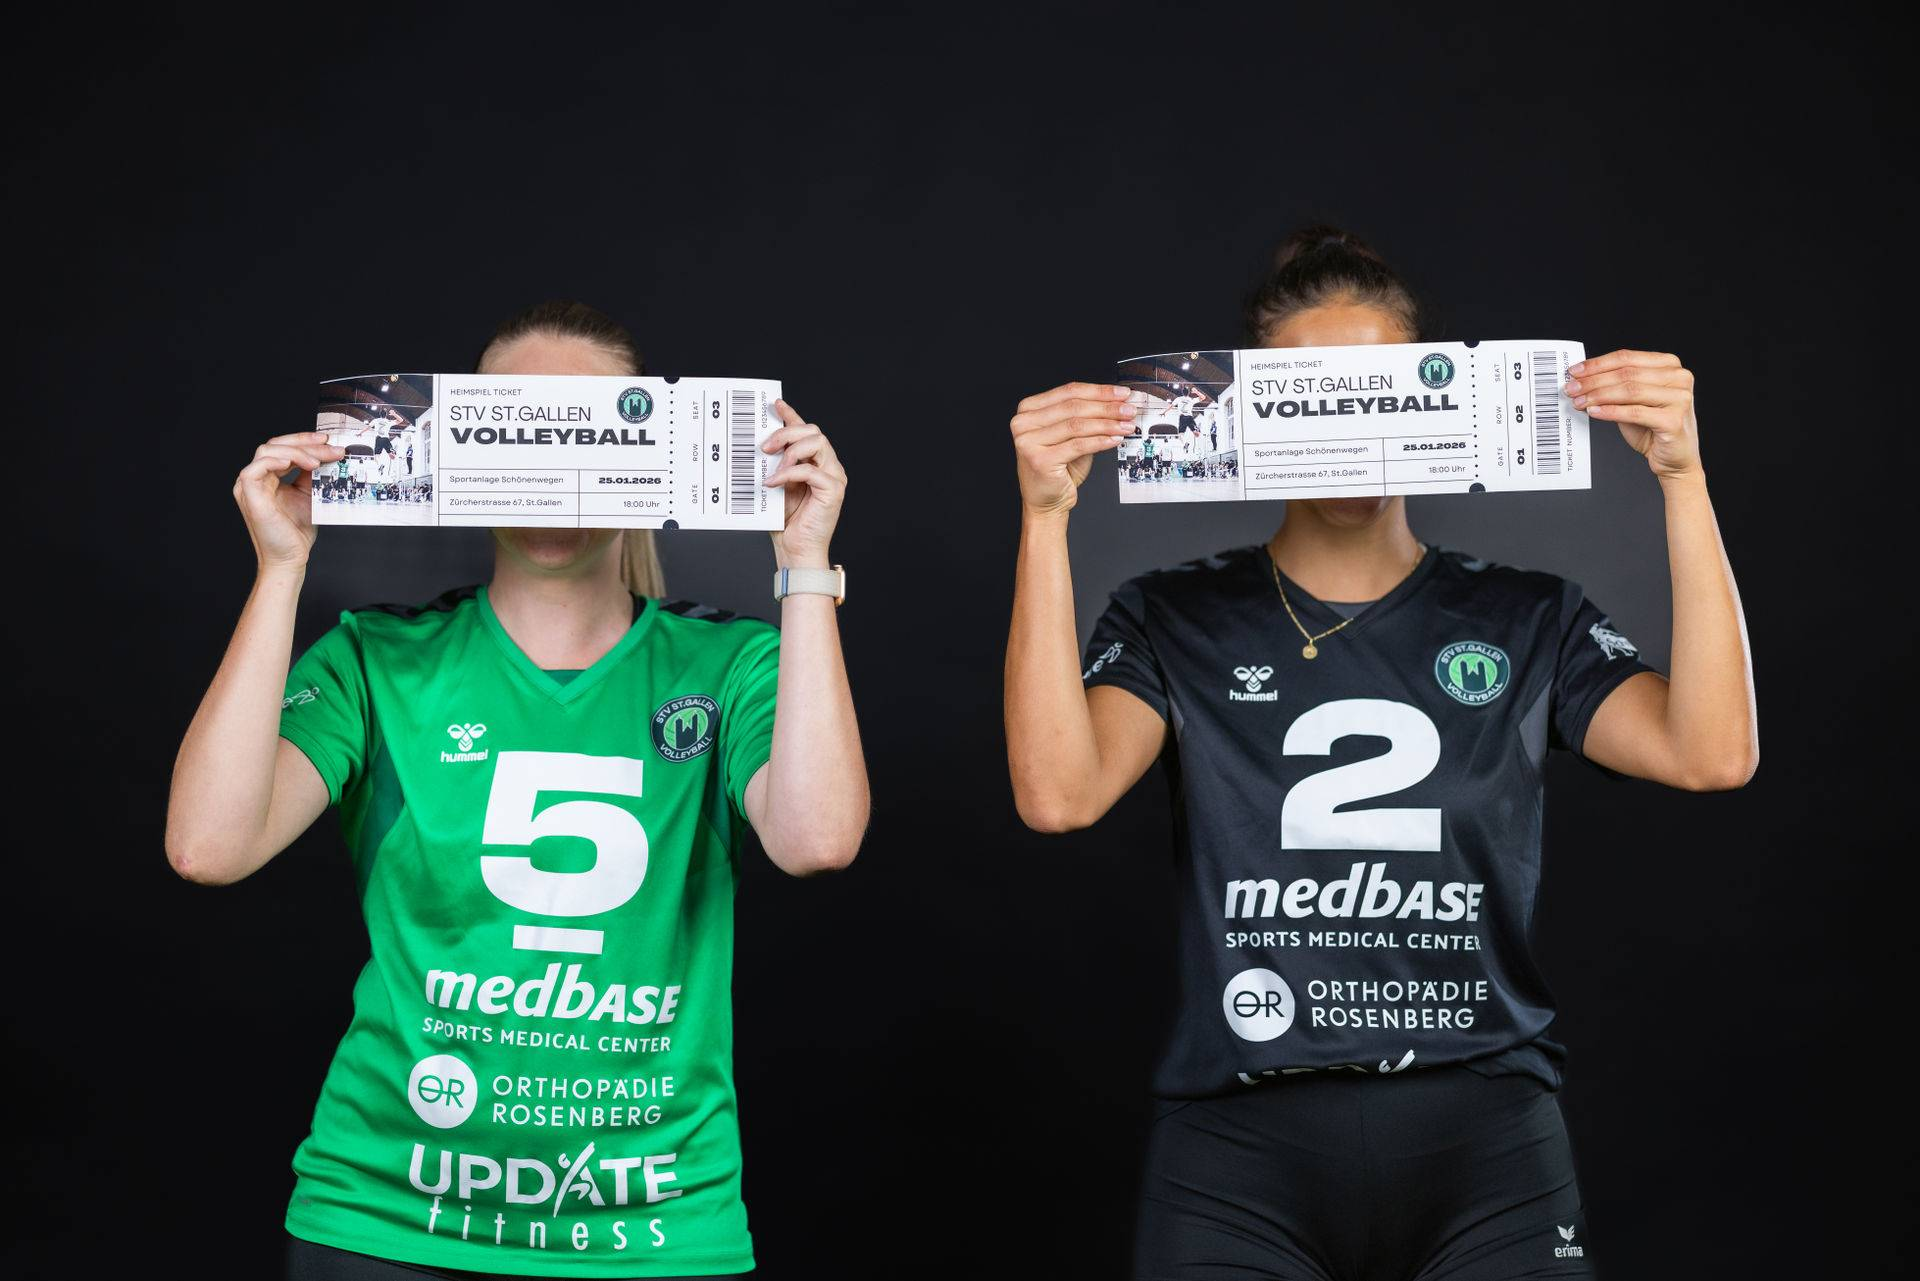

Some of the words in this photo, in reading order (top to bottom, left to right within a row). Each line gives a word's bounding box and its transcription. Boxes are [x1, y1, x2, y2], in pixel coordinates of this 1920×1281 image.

[1250, 362, 1292, 371] HEIMSPIEL
[1294, 360, 1323, 368] TICKET
[1514, 362, 1522, 380] 03
[1252, 379, 1287, 396] STV
[1292, 374, 1393, 394] ST.GALLEN
[450, 406, 486, 422] STV
[491, 406, 592, 422] ST.GALLEN
[712, 400, 720, 419] 03
[1252, 394, 1459, 419] VOLLEYBALL
[1516, 404, 1524, 424] 02
[450, 427, 656, 446] VOLLEYBALL
[712, 443, 720, 462] 02
[1254, 449, 1304, 458] Sportanlage
[1305, 446, 1368, 456] Schönenwegen
[1402, 442, 1466, 452] 25.01.2026
[1517, 448, 1526, 466] 01
[1255, 471, 1316, 480] Zürcherstrasse
[1318, 470, 1330, 478] 67,
[1331, 468, 1368, 478] St.Gallen
[1452, 465, 1466, 473] Uhr
[449, 476, 500, 484] Sportanlage
[502, 476, 564, 484] Schönenwegen
[598, 476, 662, 484] 25.01.2026
[449, 498, 511, 506] Zürcherstrasse
[512, 499, 524, 508] 67,
[526, 498, 562, 506] St.Gallen
[646, 500, 660, 508] Uhr
[712, 486, 720, 504] 01
[1441, 648, 1456, 664] STV
[1454, 644, 1503, 662] ST.GALLEN
[1229, 688, 1278, 702] hummel
[1447, 682, 1504, 702] VOLLEYBALL
[656, 706, 671, 724] STV
[671, 698, 715, 712] ST.GALLEN
[440, 748, 489, 762] hummel
[660, 736, 712, 759] VOLLEYBALL
[1281, 698, 1442, 852] 2
[480, 750, 649, 918] 5
[1225, 930, 1300, 949] SPORTS
[1308, 931, 1400, 949] MEDICAL
[1406, 932, 1481, 951] CENTER
[1307, 979, 1488, 1002] ORTHOPÄDIE
[1311, 1006, 1475, 1030] ROSENBERG
[422, 1016, 493, 1044] SPORTS
[500, 1028, 590, 1051] MEDICAL
[598, 1036, 672, 1053] CENTER
[492, 1074, 674, 1100] ORTHOPÄDIE
[492, 1102, 662, 1127] ROSENBERG
[408, 1141, 684, 1218] UPDATE
[428, 1196, 665, 1251] fitness
[1554, 1244, 1584, 1258] erima
